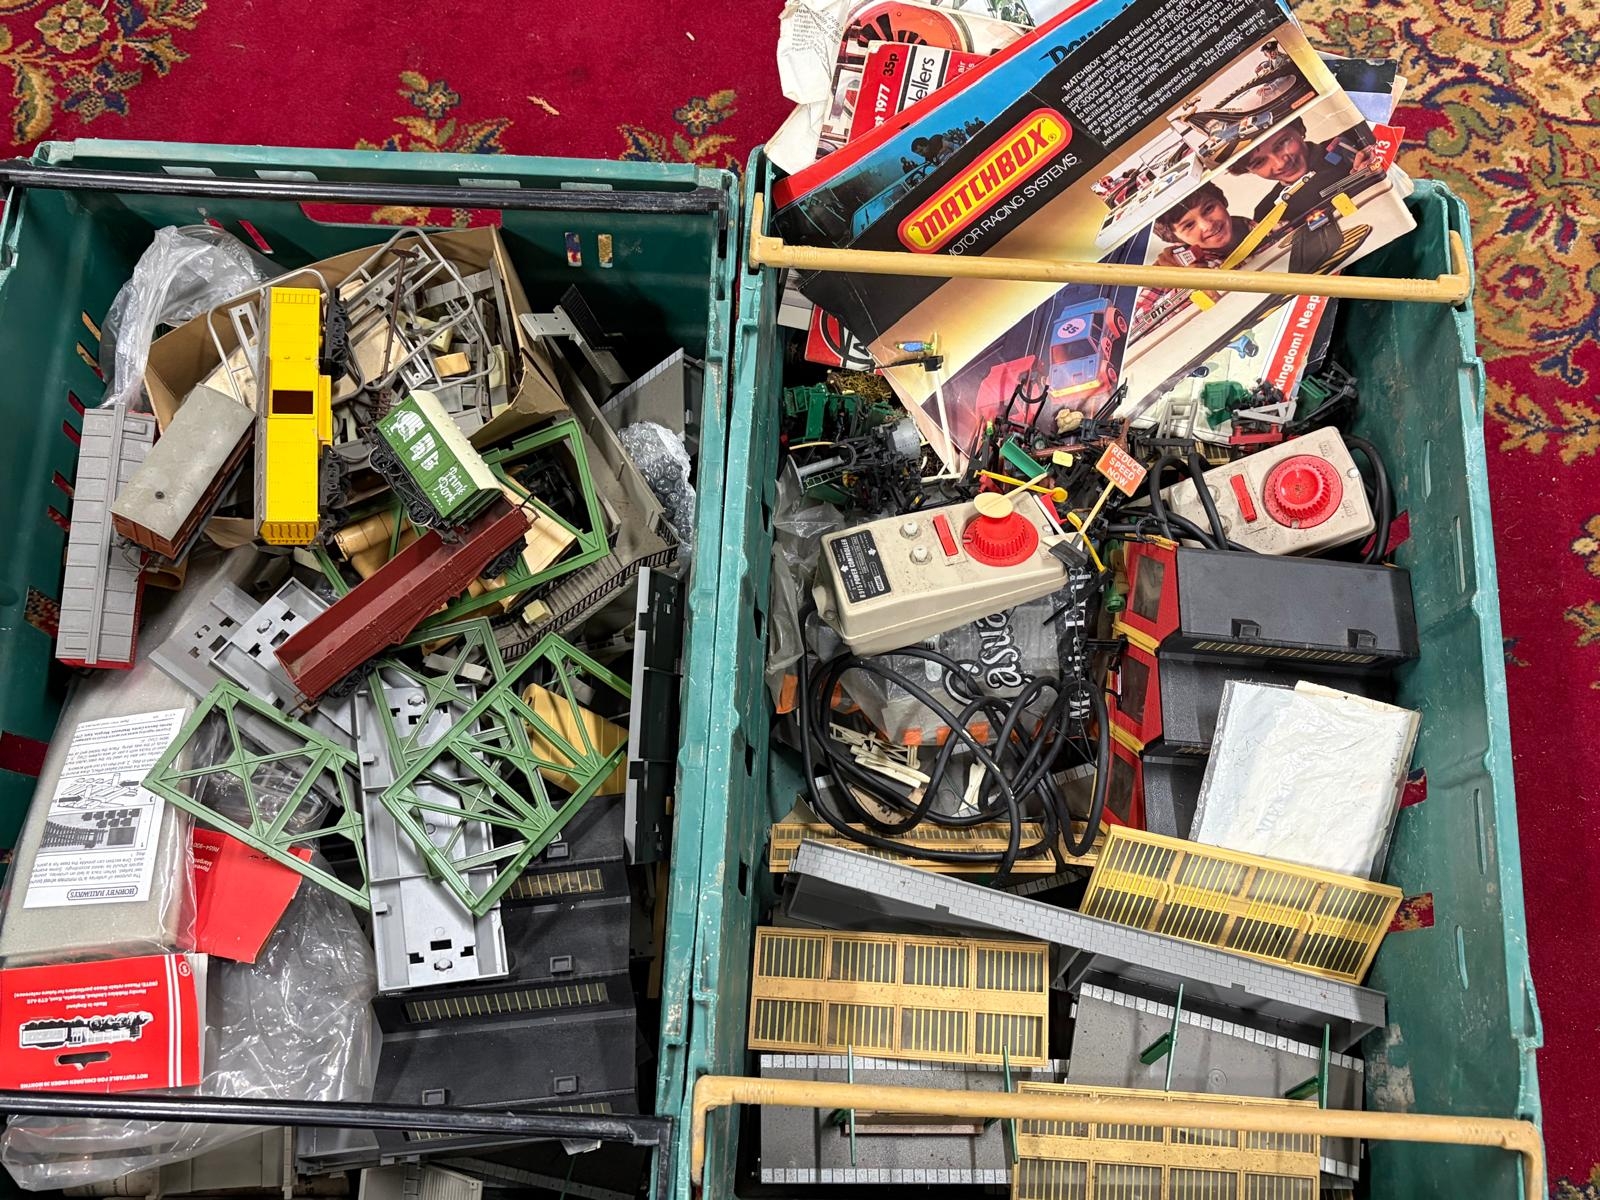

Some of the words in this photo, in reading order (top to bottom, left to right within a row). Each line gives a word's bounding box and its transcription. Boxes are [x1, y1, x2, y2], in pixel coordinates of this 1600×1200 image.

[1100, 44, 1119, 60] leads
[1117, 35, 1130, 46] the
[1128, 22, 1145, 37] field
[1144, 17, 1152, 25] in
[1152, 6, 1165, 19] slot
[882, 51, 900, 77] 35p
[1061, 85, 1082, 103] racing
[1080, 65, 1105, 88] systems
[1104, 54, 1119, 66] with
[1118, 47, 1128, 56] an
[1127, 24, 1157, 48] extensive
[1156, 9, 1176, 27] range
[1066, 75, 1104, 108] unparalleled
[1103, 60, 1126, 78] choice.
[1124, 31, 1161, 60] Powertrack
[1159, 7, 1192, 32] PT-1000,
[1070, 89, 1099, 114] PT-3000
[1098, 79, 1111, 93] and
[1109, 57, 1138, 83] PT-4000
[1137, 50, 1148, 61] are
[1152, 30, 1174, 50] proven
[1173, 20, 1186, 32] slot
[1185, 0, 1212, 23] success
[1081, 103, 1108, 124] facilities
[1107, 92, 1120, 105] and
[1118, 77, 1140, 95] topple
[1137, 62, 1161, 80] bridge.
[1158, 28, 1200, 62] Lanechanger
[1200, 13, 1219, 30] 1000
[1219, 3, 1233, 16] and
[1082, 103, 1096, 114] this
[1095, 89, 1113, 104] range
[1112, 78, 1126, 91] now
[1130, 64, 1143, 75] the
[1142, 47, 1165, 66] unique
[1164, 34, 1182, 49] Race
[1181, 28, 1189, 36] &
[1186, 13, 1208, 30] Chase
[1208, 1, 1224, 14] with
[1087, 120, 1098, 130] are
[1097, 110, 1110, 122] new
[1109, 100, 1122, 113] and
[1121, 84, 1145, 104] slotless
[1144, 70, 1158, 85] with
[1156, 60, 1174, 74] front
[1172, 44, 1192, 62] wheel
[1191, 25, 1220, 48] steering.
[1219, 3, 1246, 26] Another
[1101, 125, 1128, 146] between
[1127, 115, 1144, 127] cars,
[1142, 101, 1159, 115] track
[1158, 90, 1172, 103] and
[1171, 69, 1197, 93] controls
[1245, 23, 1258, 36] call
[1103, 126, 1113, 136] All
[1112, 108, 1138, 129] systems
[1137, 100, 1148, 110] are
[1147, 72, 1182, 102] engineered
[1189, 56, 1203, 70] give
[1202, 48, 1214, 58] the
[1214, 28, 1238, 50] perfect
[1237, 8, 1266, 31] balance
[874, 82, 891, 113] 1977
[1092, 126, 1101, 135] for
[980, 192, 1026, 231] RACING
[1022, 152, 1079, 199] SYSTEMS
[1272, 330, 1304, 391] kingdom!
[1108, 456, 1136, 481] SPEED
[1110, 446, 1144, 475] REDUCE
[1105, 466, 1128, 487] NOW
[840, 538, 855, 567] CONTROLLER
[849, 567, 861, 585] POWER
[69, 889, 105, 898] RAILWAYS
[104, 887, 135, 896] HORNBY
[65, 1001, 86, 1009] England
[19, 1080, 43, 1089] MONTHS
[50, 1078, 68, 1086] UNDER
[68, 1076, 96, 1085] CHILDREN
[96, 1075, 109, 1083] FOR
[108, 1073, 136, 1082] SUITABLE
[136, 1072, 148, 1080] NOT
